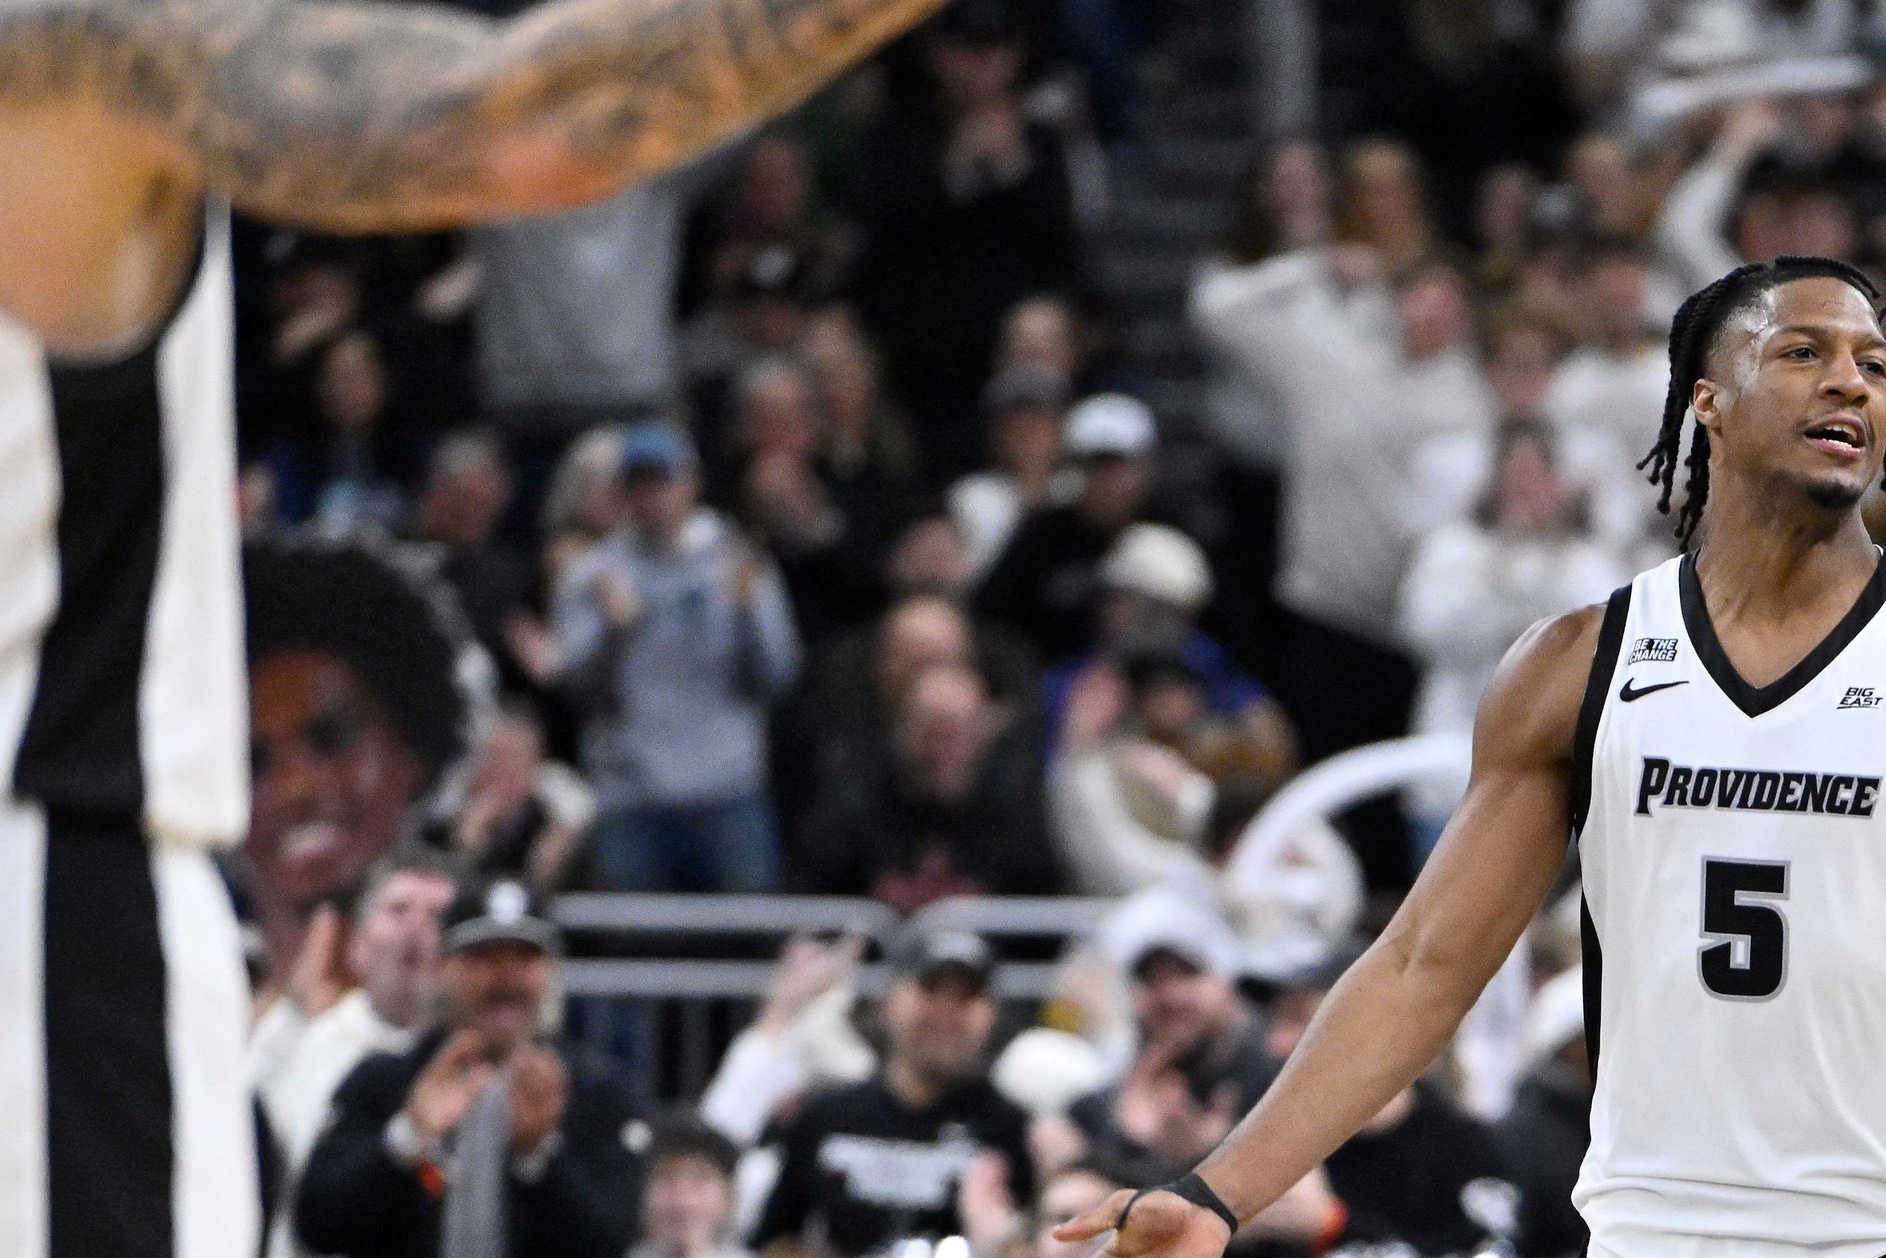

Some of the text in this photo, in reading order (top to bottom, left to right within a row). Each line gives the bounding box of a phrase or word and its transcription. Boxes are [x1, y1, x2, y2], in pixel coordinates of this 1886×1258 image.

[1633, 638, 1677, 651] BE THE
[1628, 649, 1676, 664] CHANGE
[1845, 686, 1875, 697] BIG
[1839, 696, 1884, 706] EAST
[1634, 756, 1883, 819] PROVIDENCE
[1696, 855, 1791, 1003] 5
